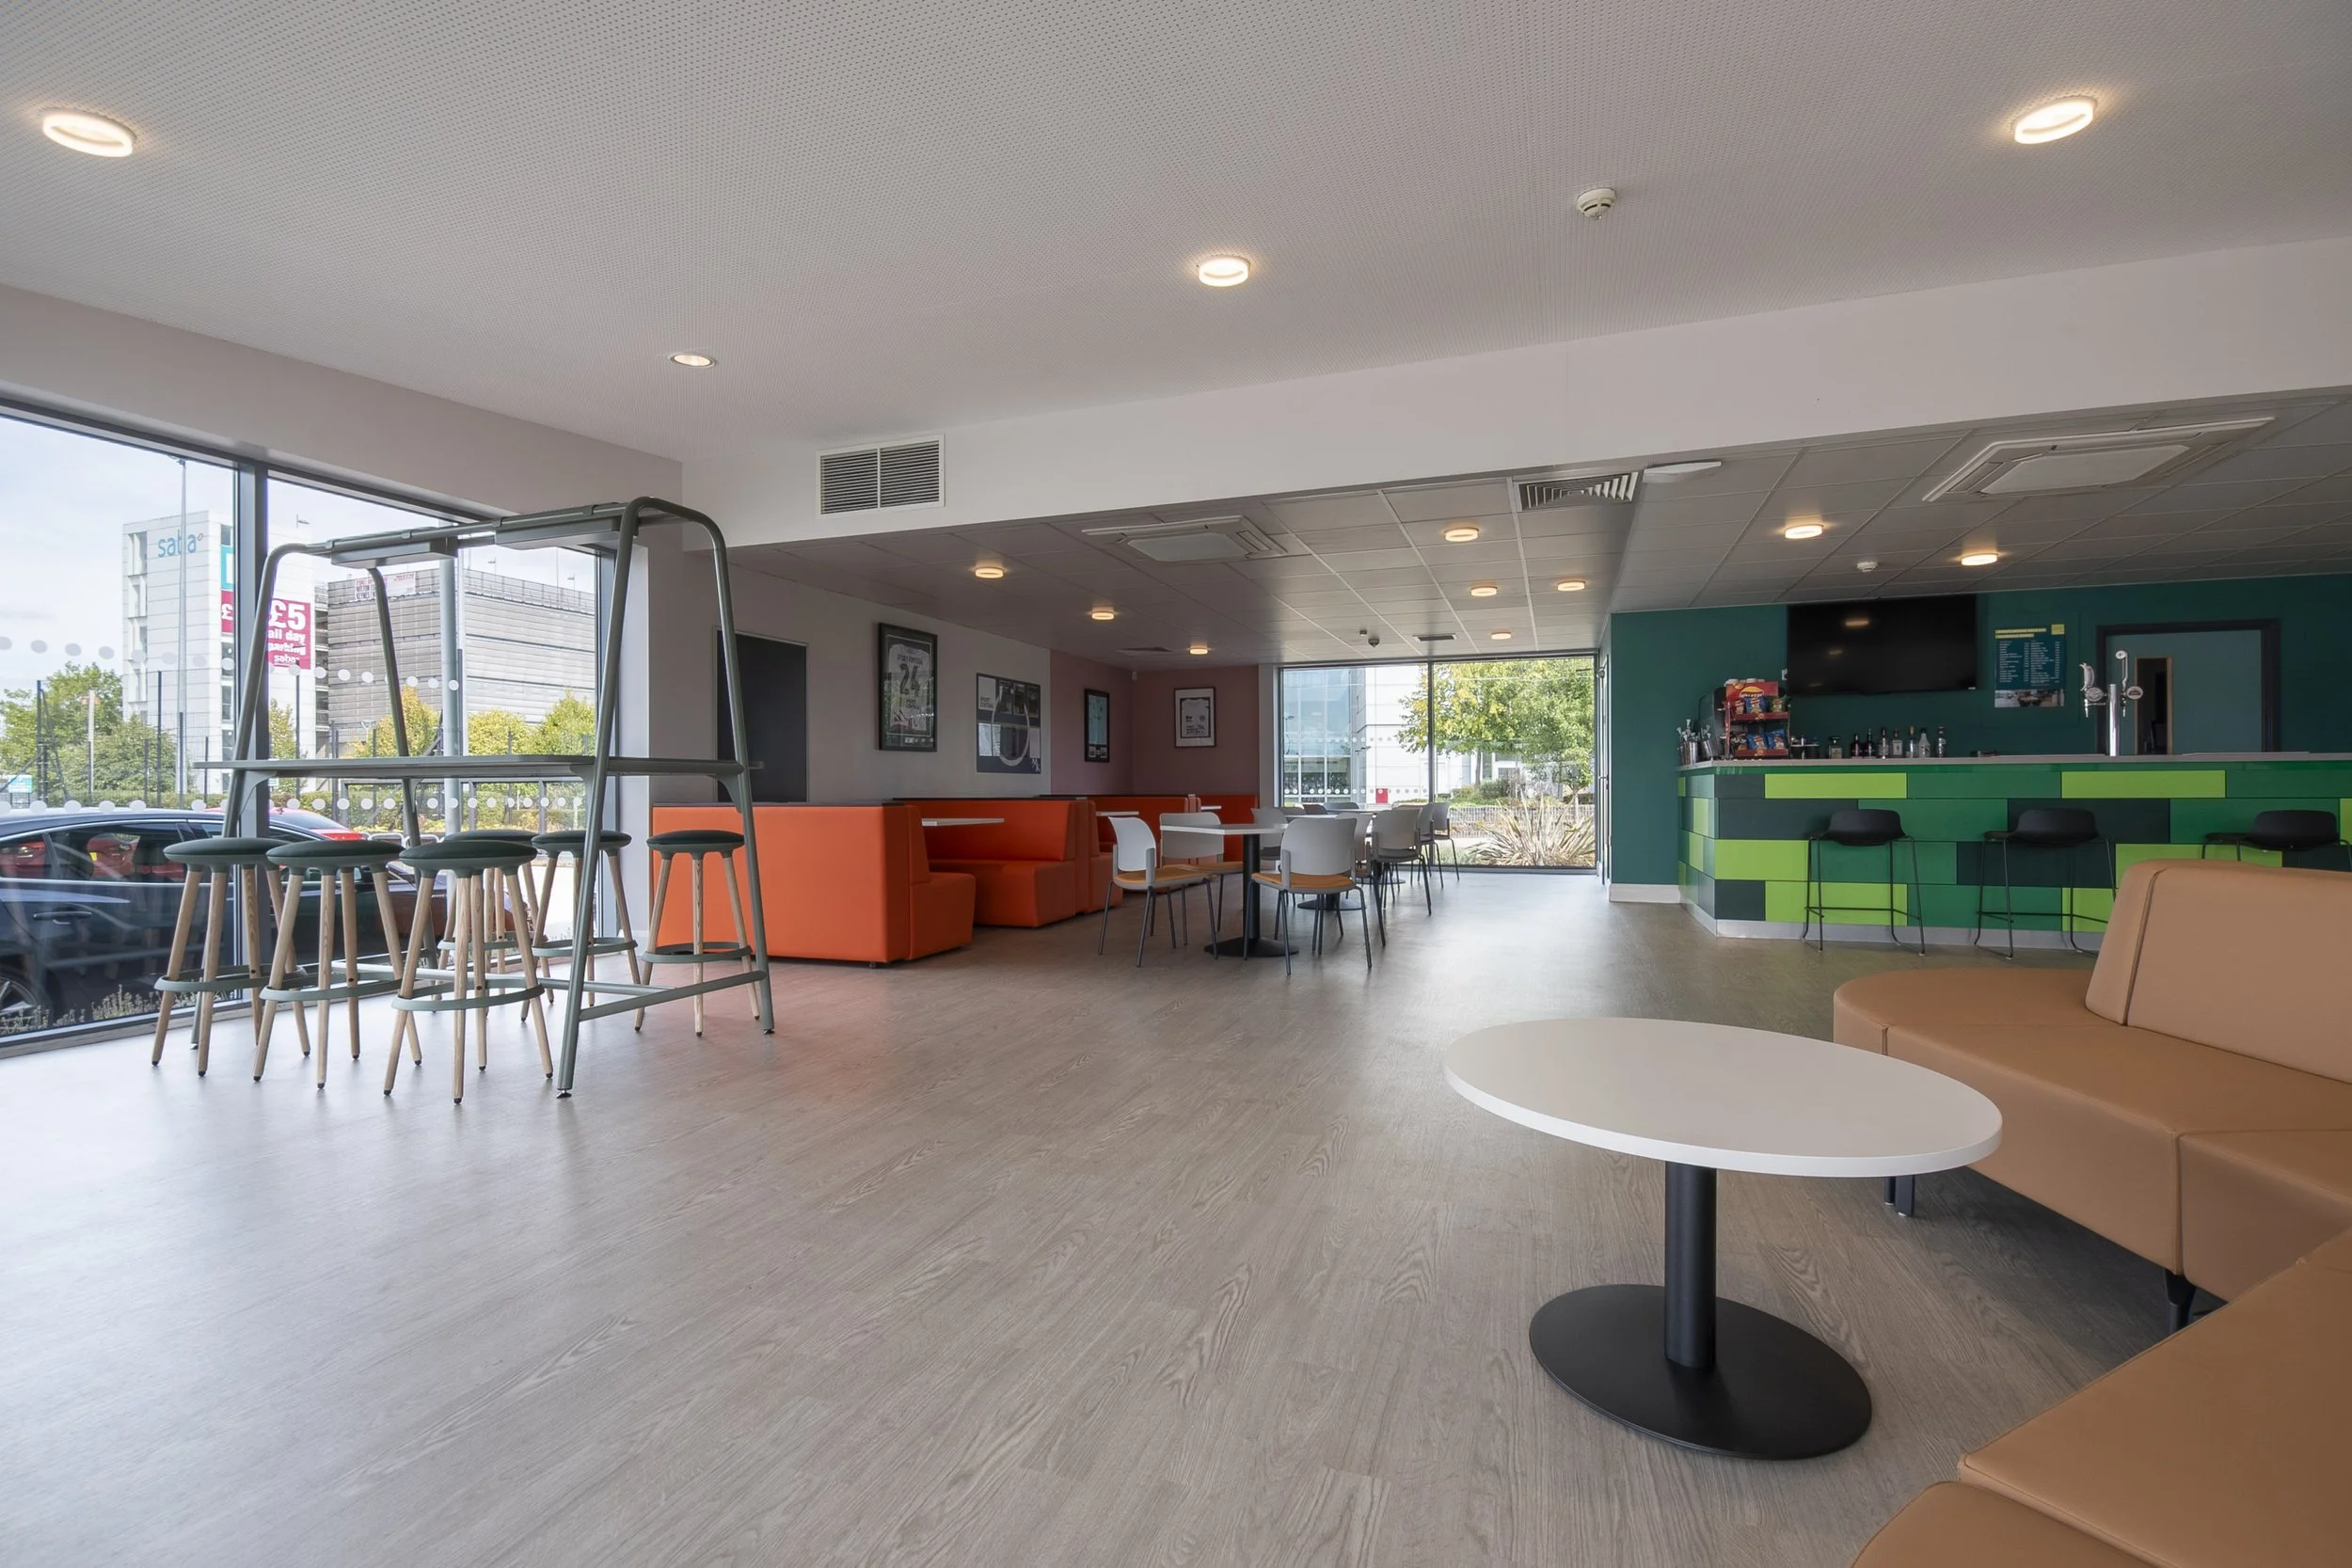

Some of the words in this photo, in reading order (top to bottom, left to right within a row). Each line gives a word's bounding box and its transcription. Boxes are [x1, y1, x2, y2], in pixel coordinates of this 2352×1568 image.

[269, 599, 306, 630] £5
[268, 628, 282, 640] all
[285, 629, 306, 643] day
[899, 663, 920, 697] 24
